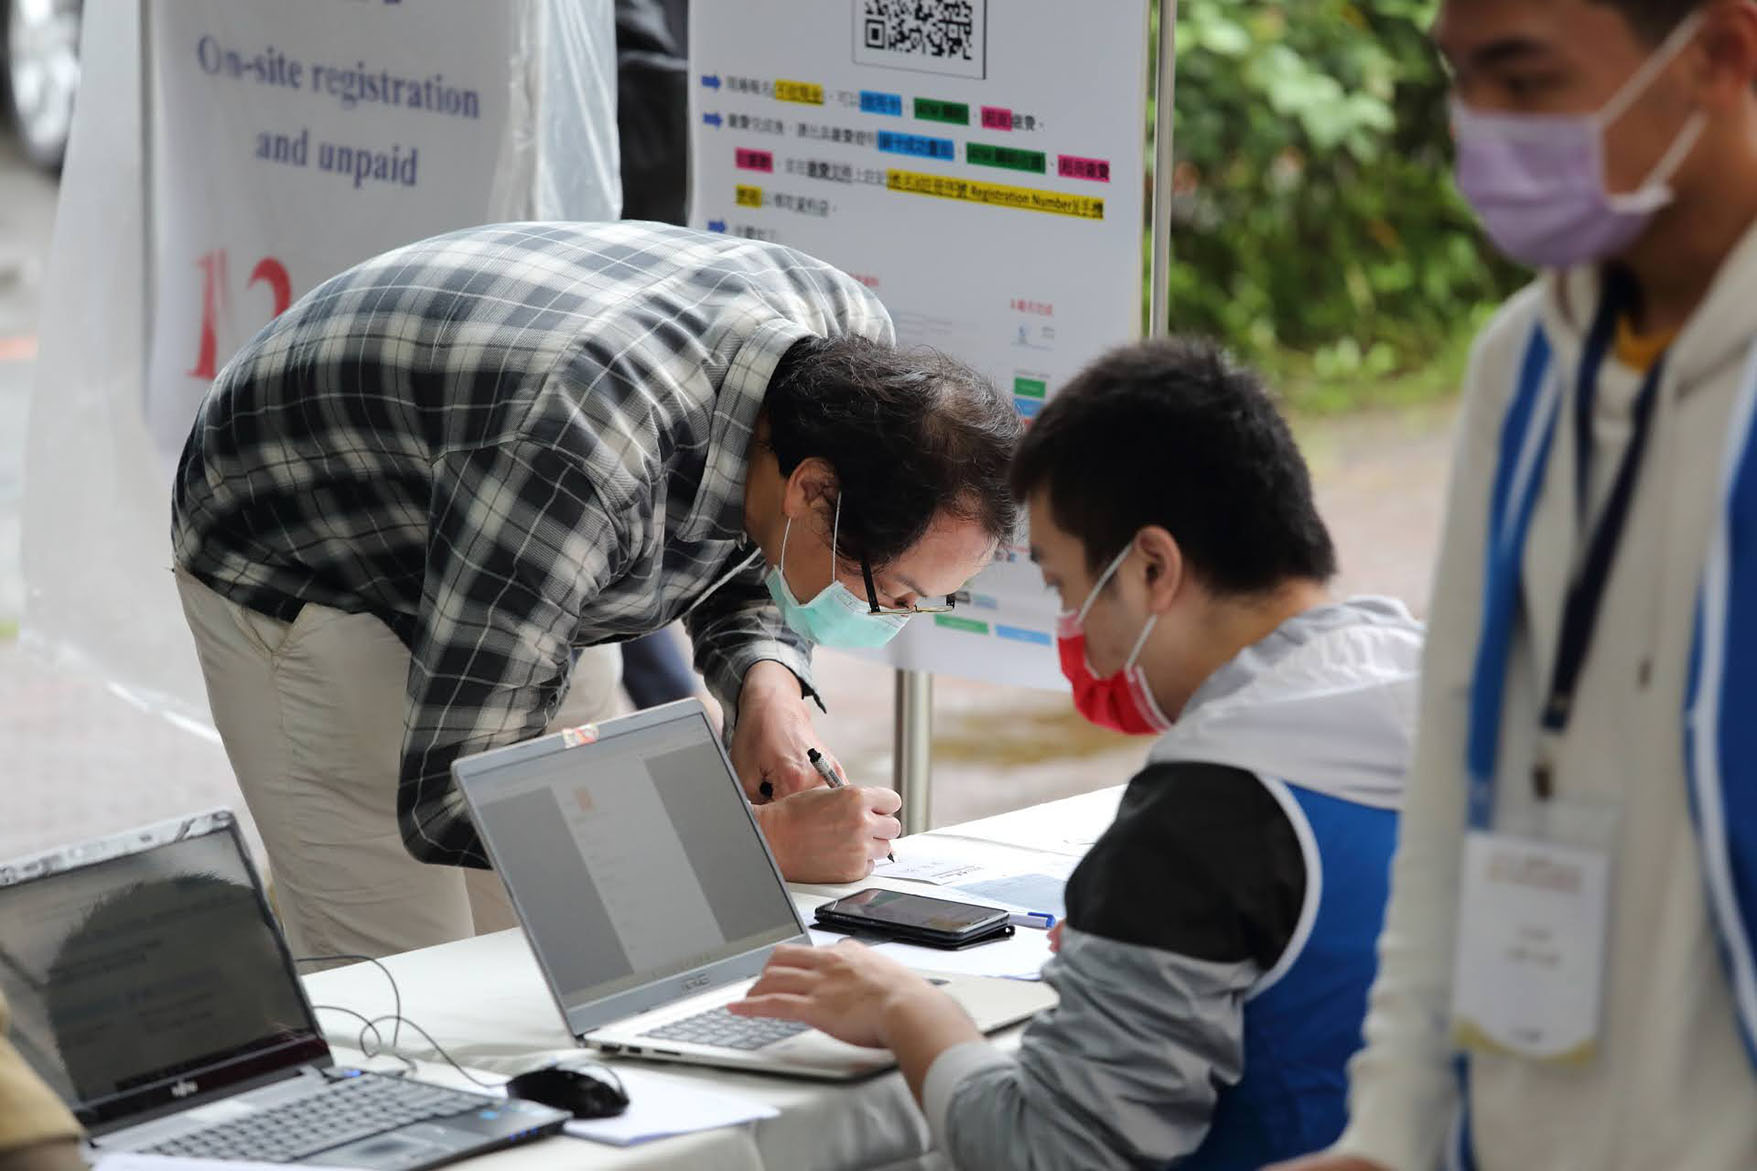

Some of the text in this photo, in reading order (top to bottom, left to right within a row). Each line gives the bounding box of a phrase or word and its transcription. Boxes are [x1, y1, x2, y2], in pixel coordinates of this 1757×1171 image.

[197, 34, 481, 119] On-site registration
[255, 129, 418, 189] and unpaid
[971, 185, 1029, 204] Registration
